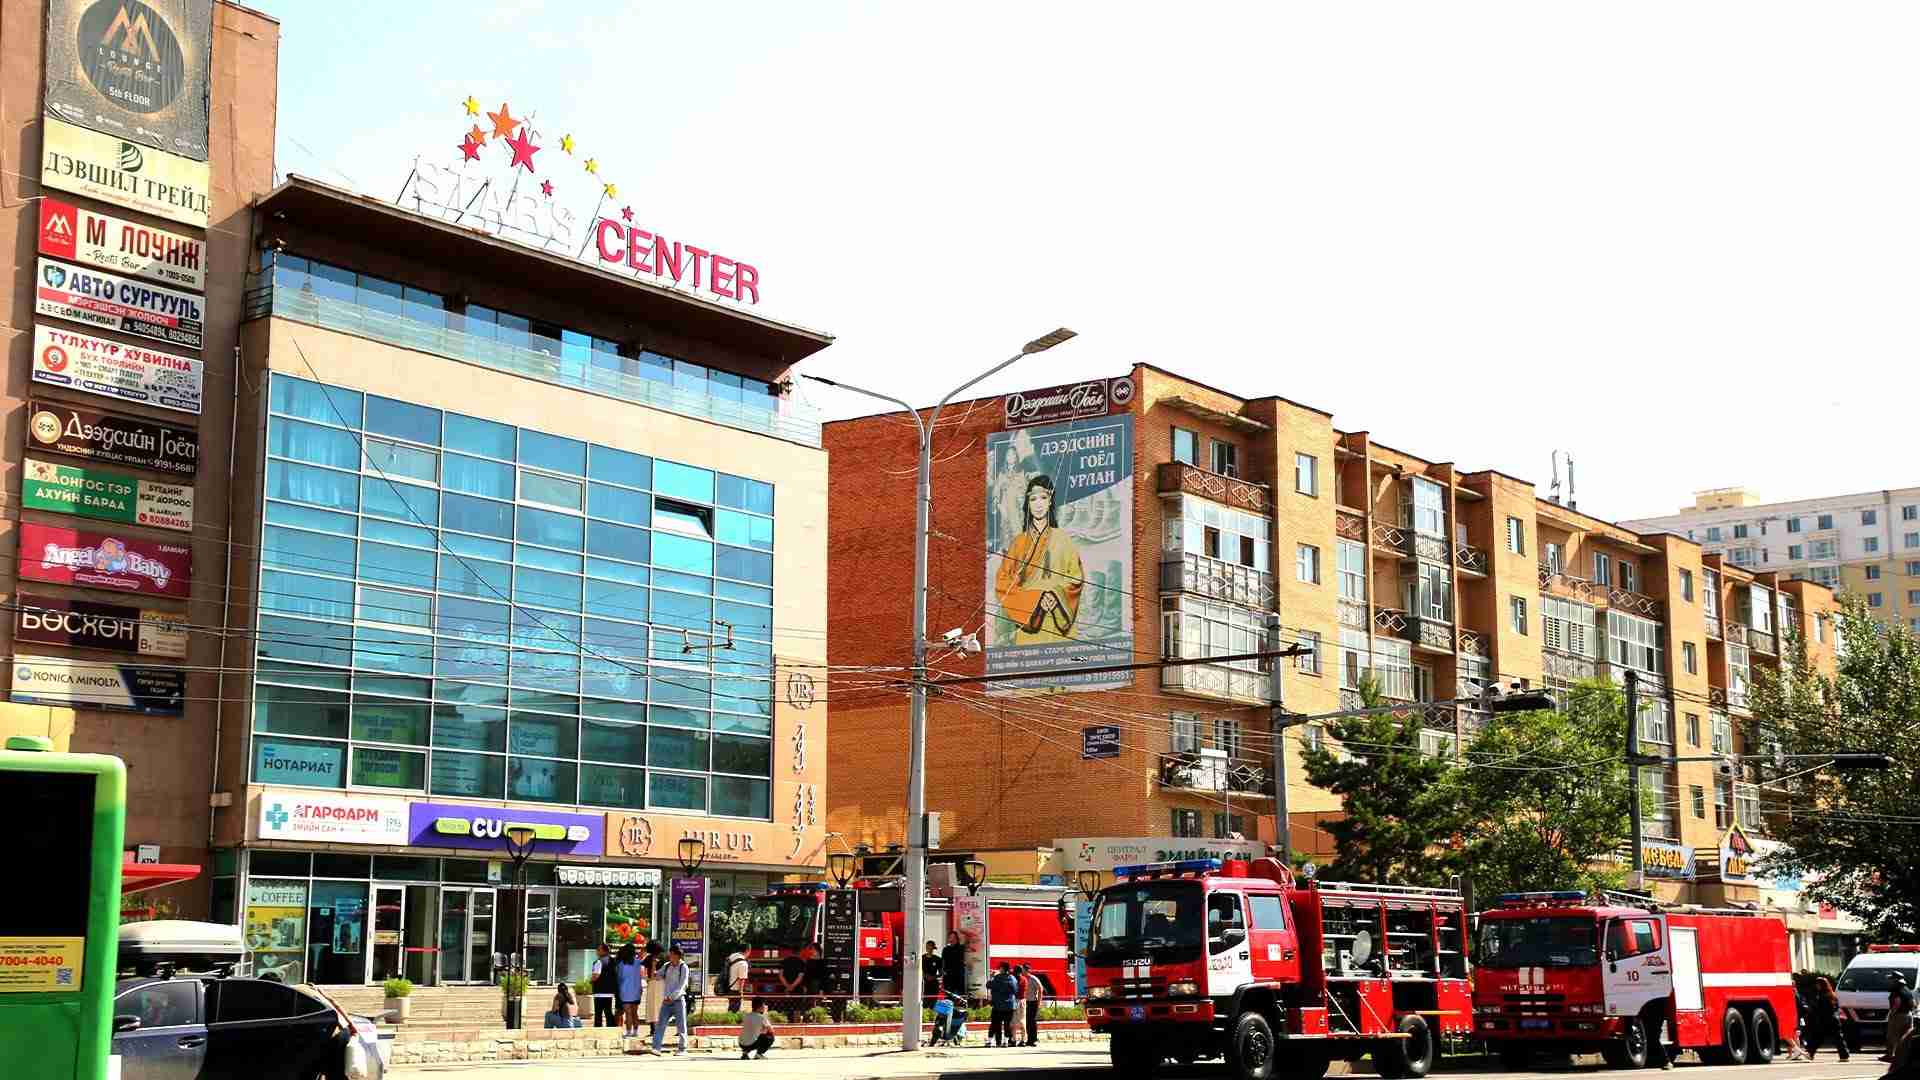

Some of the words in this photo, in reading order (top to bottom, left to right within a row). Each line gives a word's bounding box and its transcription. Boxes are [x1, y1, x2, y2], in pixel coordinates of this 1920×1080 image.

[124, 88, 151, 105] FLOOR
[45, 152, 137, 194] ДЭВШИЛ
[144, 178, 208, 215] ТРЕЙД
[86, 215, 106, 247] М
[120, 225, 200, 271] ЛОУНЖ
[596, 216, 760, 304] CENTER
[69, 272, 115, 300] АВТО
[120, 284, 200, 320] СУРГУУЛЬ
[49, 331, 119, 355] ТҮЛХҮҮР
[124, 348, 192, 372] ХУВИЛНА
[64, 411, 155, 451] Дээдсийн
[160, 428, 196, 459] Гоёл
[1041, 432, 1115, 457] ДЭЭДСИЙН
[1080, 450, 1115, 469] ГОЁЛ
[108, 481, 132, 496] ГЭР
[1069, 470, 1115, 488] УРЛАН
[36, 487, 80, 503] АХУЙН
[83, 496, 126, 511] БАРАА
[41, 543, 94, 571] Angel
[129, 553, 171, 588] Baby
[22, 607, 134, 640] БӨСХӨН
[34, 672, 73, 684] KONICA
[76, 677, 121, 689] MINOLTA
[264, 757, 335, 774] НОТАРИАТ
[472, 818, 503, 837] CU
[1156, 847, 1220, 861] ЭМИЙН
[262, 892, 302, 904] COFFEE
[1122, 957, 1151, 966] ISUZU
[1626, 970, 1639, 982] 10
